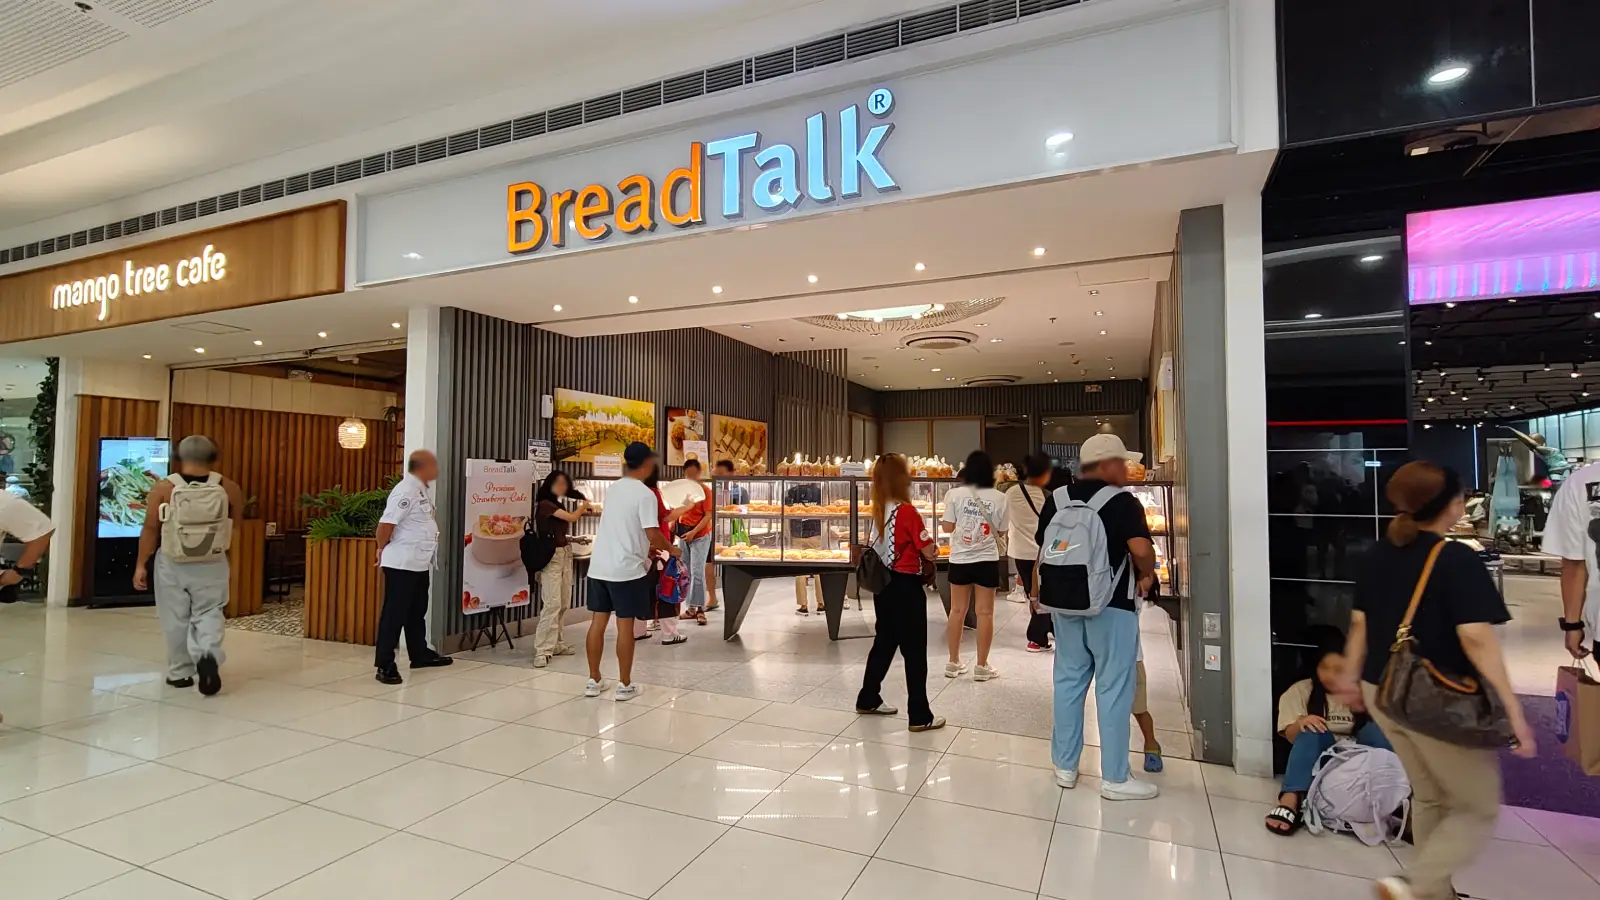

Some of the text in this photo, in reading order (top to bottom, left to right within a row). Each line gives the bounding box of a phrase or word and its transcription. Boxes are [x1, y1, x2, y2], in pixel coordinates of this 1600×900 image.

[53, 244, 227, 321] mango tree cafe
[483, 465, 517, 473] BreadTalk
[484, 481, 516, 493] Premium
[471, 491, 528, 504] Strawberry Cake
[1270, 807, 1296, 823] NIKE
